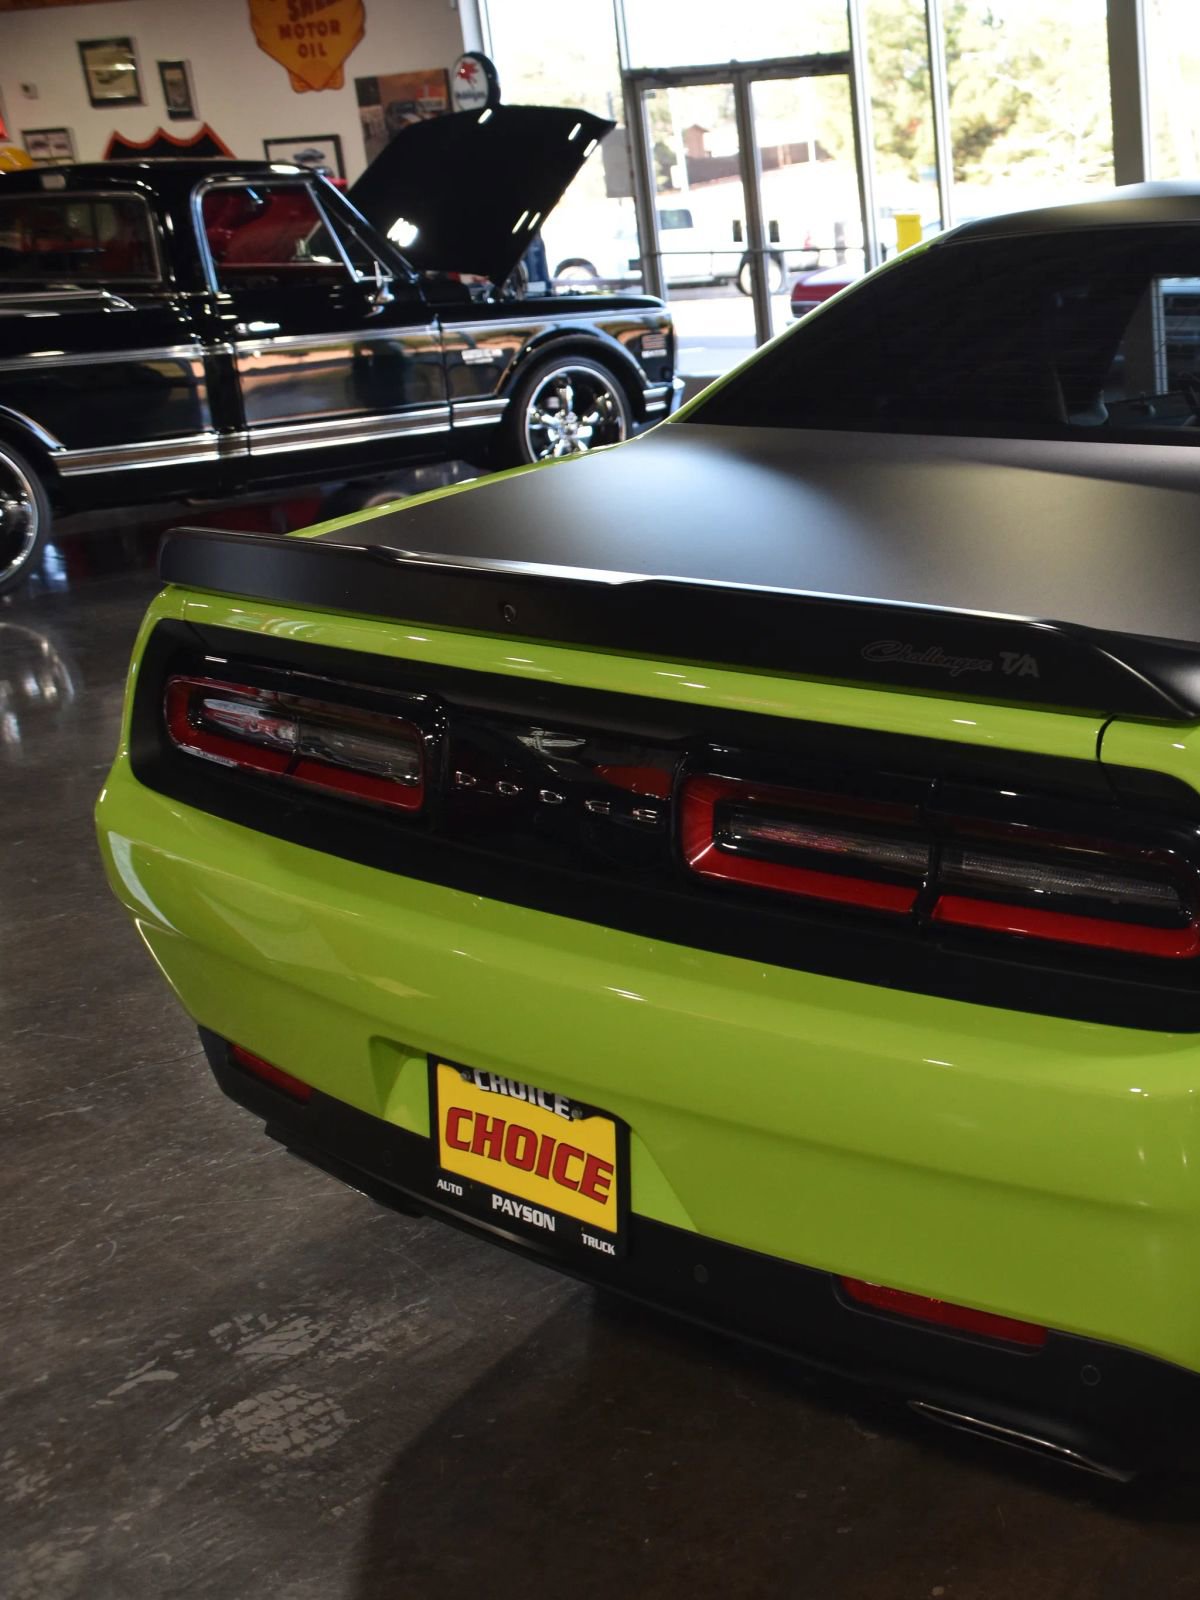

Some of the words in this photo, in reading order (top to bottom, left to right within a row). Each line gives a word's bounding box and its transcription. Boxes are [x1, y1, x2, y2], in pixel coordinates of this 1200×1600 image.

[278, 19, 341, 39] MOTOR
[297, 42, 327, 58] OIL
[861, 640, 992, 677] Challenger
[455, 770, 659, 825] DODGE
[445, 1106, 615, 1205] CHOICE
[437, 1179, 463, 1196] AUTO
[491, 1193, 556, 1232] PAYSON
[581, 1233, 616, 1256] TRUCK
